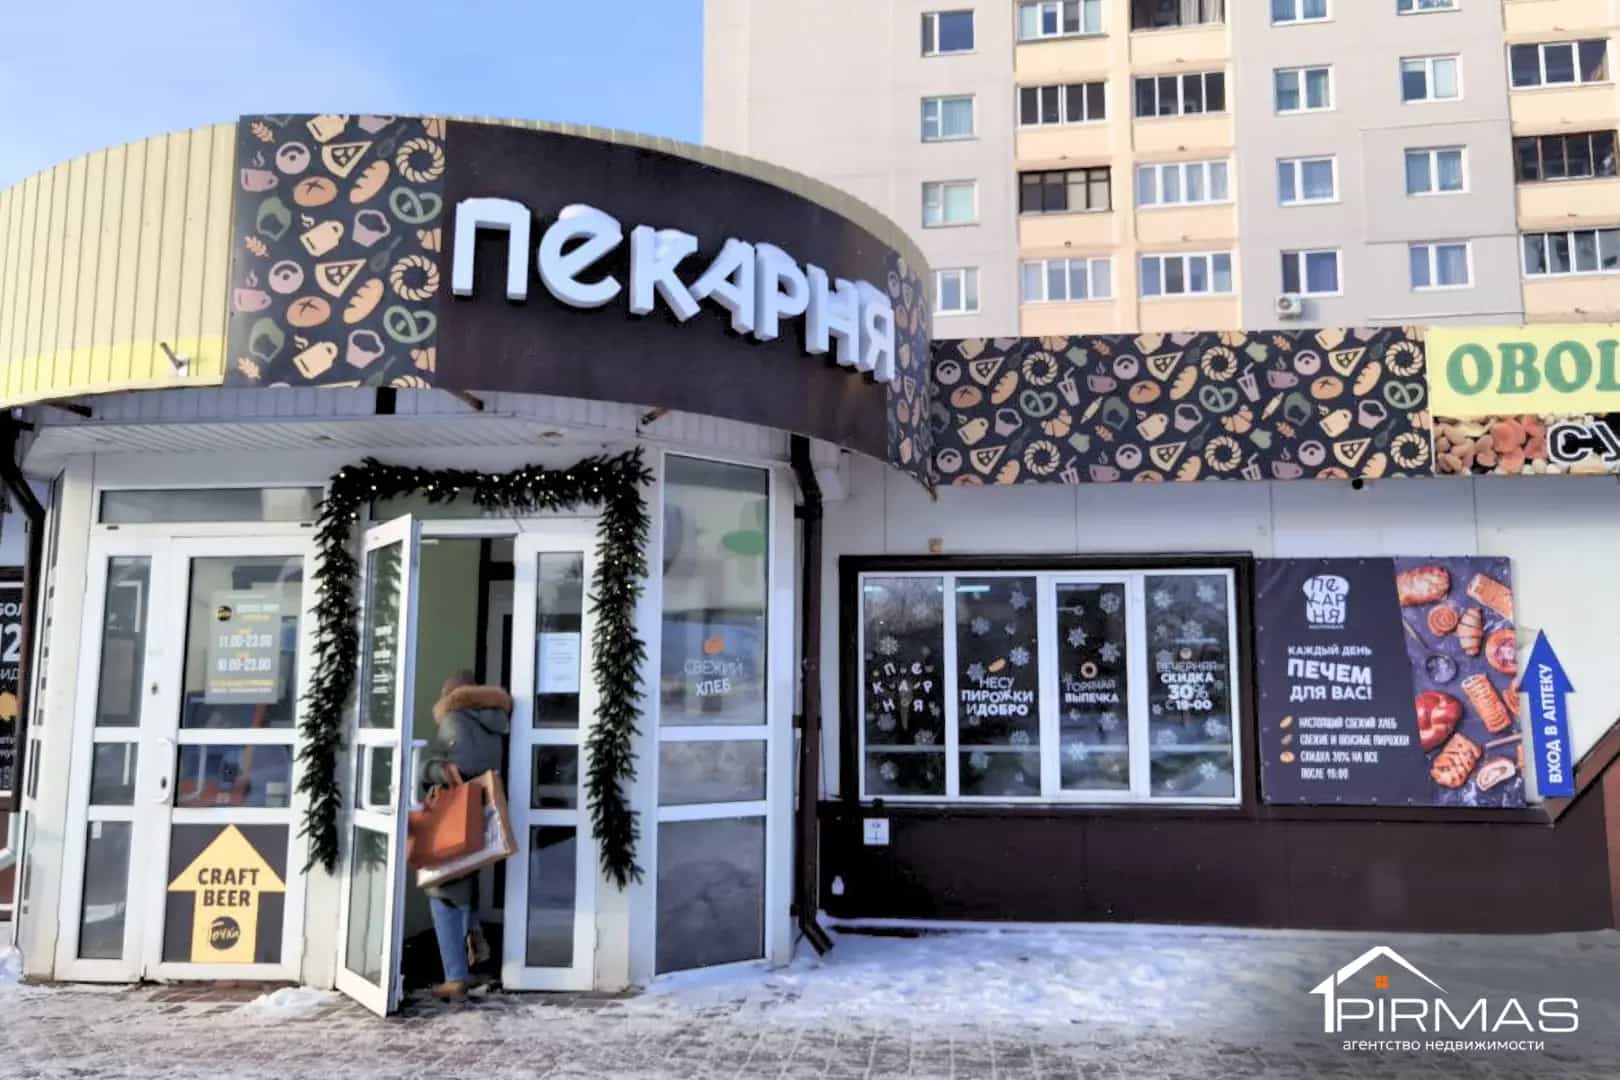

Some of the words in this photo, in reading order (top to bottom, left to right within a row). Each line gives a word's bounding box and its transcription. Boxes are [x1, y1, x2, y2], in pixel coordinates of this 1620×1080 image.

[1287, 644, 1339, 656] КАЖДЫЙ
[1342, 646, 1372, 656] ДЕНЬ
[1161, 672, 1215, 684] СКИДКА
[1287, 658, 1372, 685] ПЕЧЕМ
[695, 678, 732, 697] ХЛЕБ
[979, 676, 1015, 690] НЕСУ
[961, 689, 1034, 703] ПИРОЖКИ
[1064, 692, 1120, 704] ВЫПЕЧКА
[1167, 684, 1209, 700] 30%
[1290, 685, 1327, 702] ДЛЯ
[1332, 685, 1372, 701] ВАС!
[1538, 663, 1557, 722] АПТЕКУ
[1378, 718, 1397, 729] ХЛЕБ
[1544, 725, 1558, 736] В
[1330, 735, 1338, 745] И
[1373, 735, 1410, 746] ПИРОЖКИ
[1300, 751, 1330, 762] СКИДКА
[1352, 752, 1362, 762] НА
[1546, 738, 1563, 784] ВХОД
[1301, 767, 1325, 779] ПОСЛЕ
[197, 867, 260, 886] CRAFT
[203, 889, 251, 907] BEER
